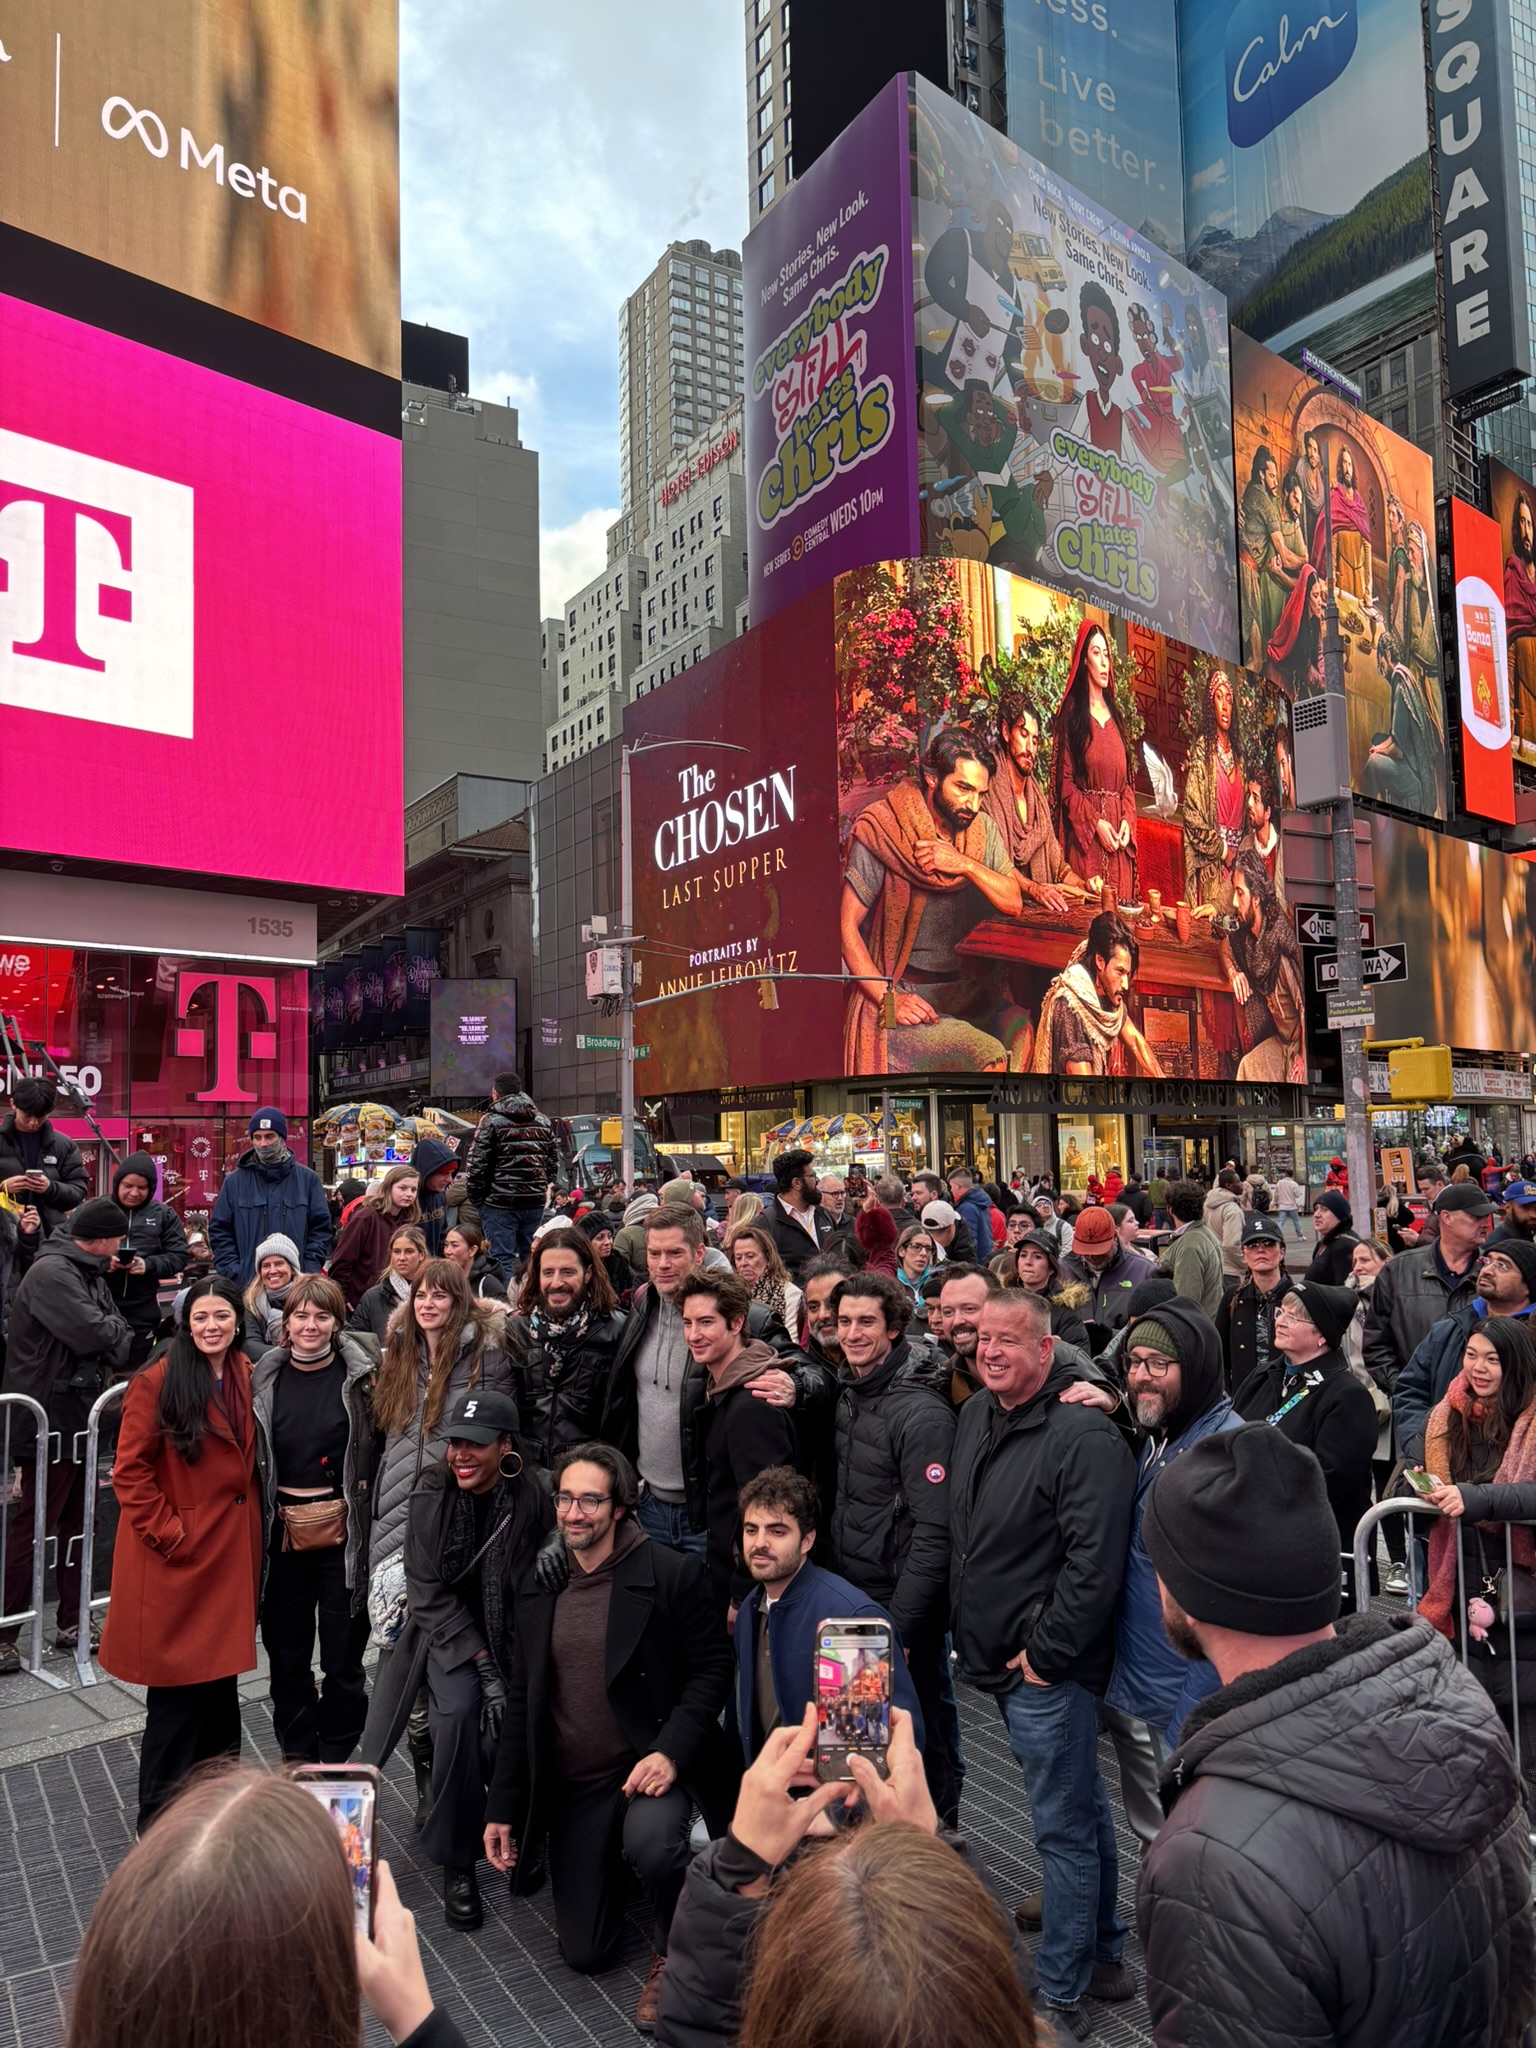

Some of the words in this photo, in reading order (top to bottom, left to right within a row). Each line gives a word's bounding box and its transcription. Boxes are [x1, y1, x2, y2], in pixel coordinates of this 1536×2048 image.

[1036, 0, 1118, 38] ess.
[1037, 45, 1116, 112] Live
[1233, 11, 1348, 103] Calm
[180, 127, 307, 224] Meta
[1039, 99, 1166, 192] better.
[1435, 0, 1490, 347] SQUARE
[761, 278, 778, 307] New
[780, 244, 815, 287] Stories.
[816, 218, 837, 250] New
[840, 190, 869, 229] Look.
[1033, 194, 1056, 227] New
[1059, 213, 1100, 257] Stories.
[1102, 242, 1123, 273] New
[1125, 258, 1152, 292] Look.
[1065, 238, 1095, 274] Same
[1097, 260, 1127, 296] Chris.
[783, 272, 808, 307] Same
[810, 245, 839, 280] Chris.
[754, 252, 884, 394] everybody
[792, 363, 856, 447] hates
[660, 467, 693, 509] HOTEL
[696, 427, 739, 480] EDISON
[759, 382, 889, 523] chris
[1053, 432, 1155, 503] everybody
[804, 516, 829, 541] COMEDY
[804, 529, 831, 553] CENTRAL
[830, 498, 858, 535] WEDS
[860, 487, 884, 516] 10PM
[1091, 518, 1138, 547] hates
[0, 479, 132, 672] T
[763, 559, 774, 578] NEW
[774, 547, 791, 570] SERIES
[1056, 522, 1157, 603] chris
[1465, 623, 1491, 647] Banza
[678, 764, 716, 804] The
[654, 764, 797, 871] CHOSEN
[662, 876, 703, 909] LAST
[713, 847, 788, 893] SUPPER
[247, 917, 293, 938] 1535
[689, 942, 742, 968] PORTRAITS
[746, 937, 758, 954] BY
[1309, 921, 1332, 935] ONE
[658, 972, 703, 998] ANNIE
[1364, 957, 1391, 973] WAY
[1346, 999, 1366, 1008] Square
[177, 972, 277, 1103] T
[586, 1037, 620, 1050] Broadway
[57, 1065, 102, 1096] 50
[1453, 1069, 1481, 1094] SLAM
